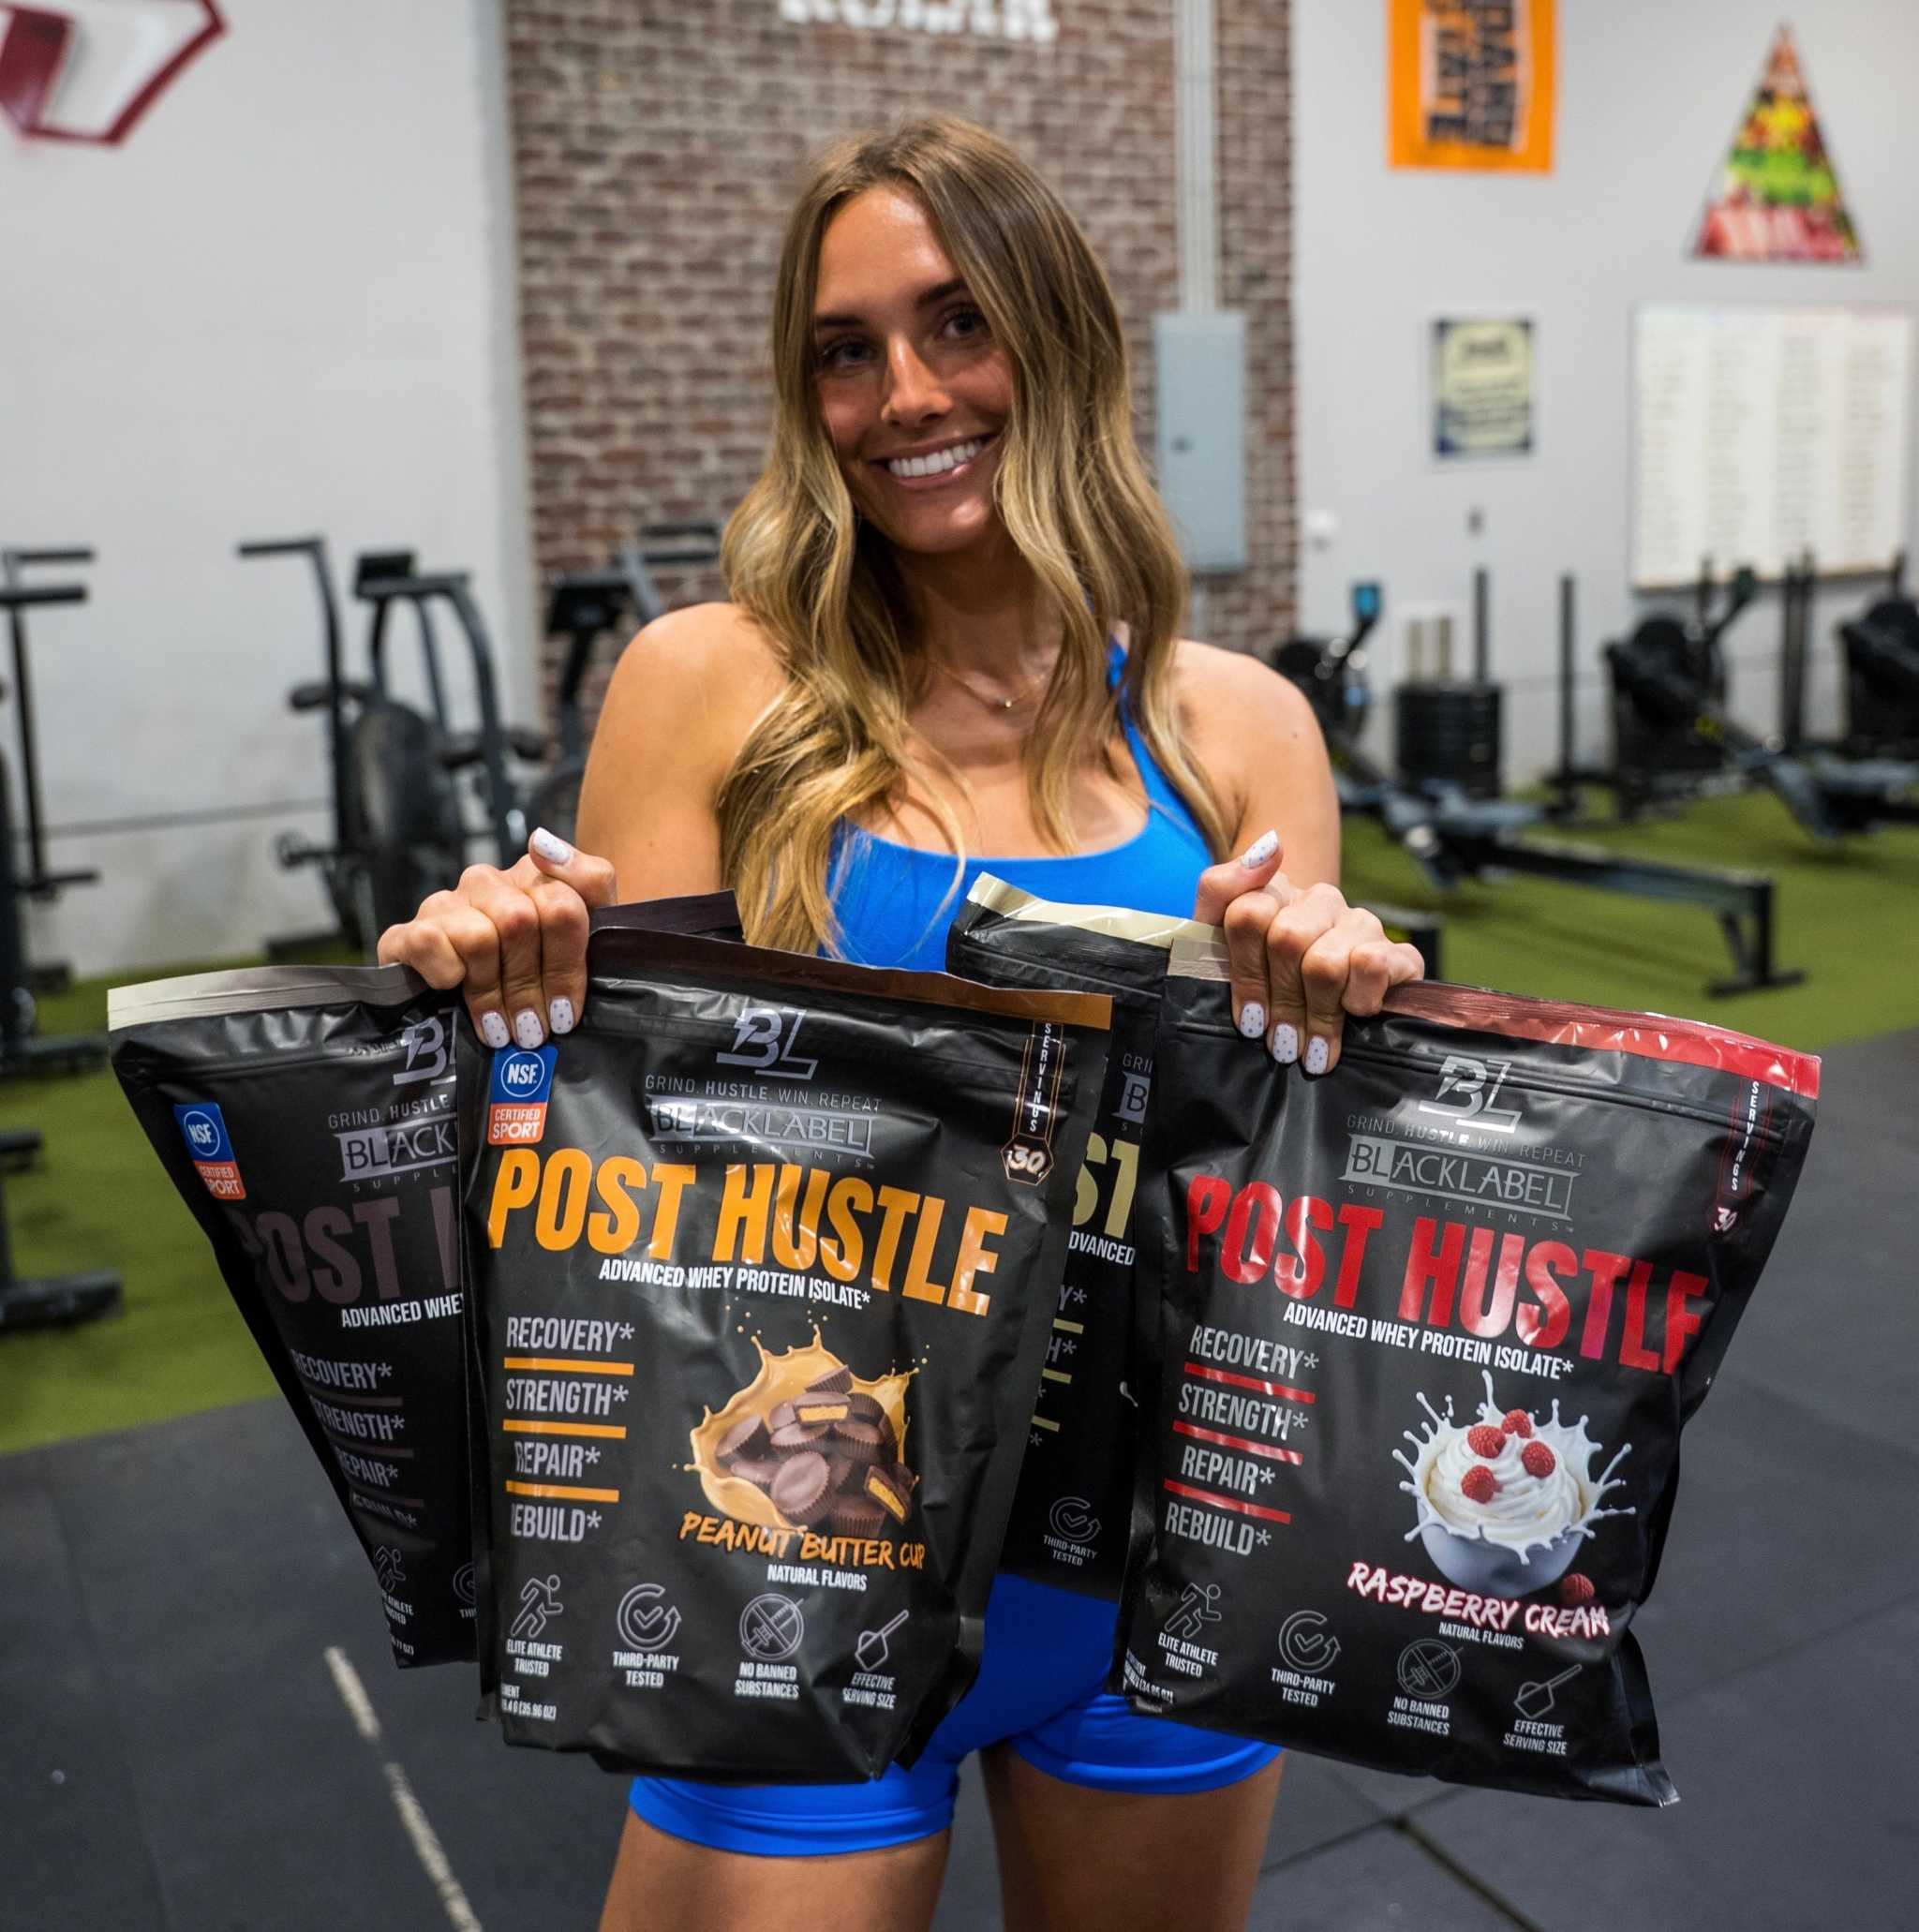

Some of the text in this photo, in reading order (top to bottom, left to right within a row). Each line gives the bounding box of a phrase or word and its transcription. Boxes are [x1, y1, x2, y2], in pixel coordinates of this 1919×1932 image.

[716, 1007, 819, 1079] BL
[507, 1063, 537, 1084] NSF
[1030, 1023, 1051, 1133] SERVINGS
[819, 1092, 884, 1111] REPEAT
[1419, 1055, 1522, 1134] BL
[495, 1108, 540, 1122] CERTIFIED
[658, 1103, 867, 1147] BLACKLABEL
[187, 1123, 212, 1144] NSF
[492, 1122, 540, 1138] SPORT
[346, 1122, 457, 1170] BLACK
[1519, 1143, 1586, 1167] REPEAT
[1006, 1144, 1047, 1175] 30
[1072, 1132, 1140, 1240] ST
[1351, 1142, 1562, 1210] BLACKLABEL
[487, 1148, 696, 1261] POST
[712, 1164, 1008, 1316] HUSTLE
[1069, 1230, 1137, 1266] DVANCED
[599, 1258, 684, 1287] ADVANCED
[688, 1267, 734, 1290] WHEY
[736, 1270, 806, 1299] PROTEIN
[1186, 1174, 1709, 1375] POST HUSTLE
[341, 1292, 464, 1329] ADVANCED WHE
[1284, 1301, 1367, 1339] ADVANCED
[1371, 1318, 1418, 1349] WHEY
[1421, 1330, 1492, 1365] PROTEIN
[678, 1511, 926, 1570] PEANUT BUTTER CUP
[1043, 1534, 1098, 1568] THIRD-PARTY
[1052, 1549, 1083, 1566] TESTED
[767, 1564, 868, 1591] NATURAL FLAVORS
[1346, 1561, 1611, 1639] RASPBERRY CREAM
[1158, 1632, 1219, 1666] ELITE ATHLETE
[1438, 1622, 1525, 1650] NATURAL FLAVORS
[507, 1639, 563, 1661] ELITE ATHLETE
[613, 1651, 679, 1672] THIRD-PARTY
[514, 1657, 550, 1677] TRUSTED
[740, 1662, 797, 1681] NO BANNED
[1165, 1652, 1203, 1678] TRUSTED
[626, 1670, 664, 1688] TESTED
[735, 1679, 799, 1699] SUBSTANCES
[851, 1672, 895, 1691] EFFECTIVE
[1271, 1668, 1335, 1695] THIRD-PARTY
[842, 1688, 896, 1710] SERVING SIZE
[1282, 1687, 1318, 1707] TESTED
[1393, 1696, 1450, 1718] NO BANNED
[1387, 1710, 1450, 1735] SUBSTANCES
[1513, 1718, 1565, 1739] EFFECTIVE
[1503, 1732, 1568, 1756] SERVING SIZE
